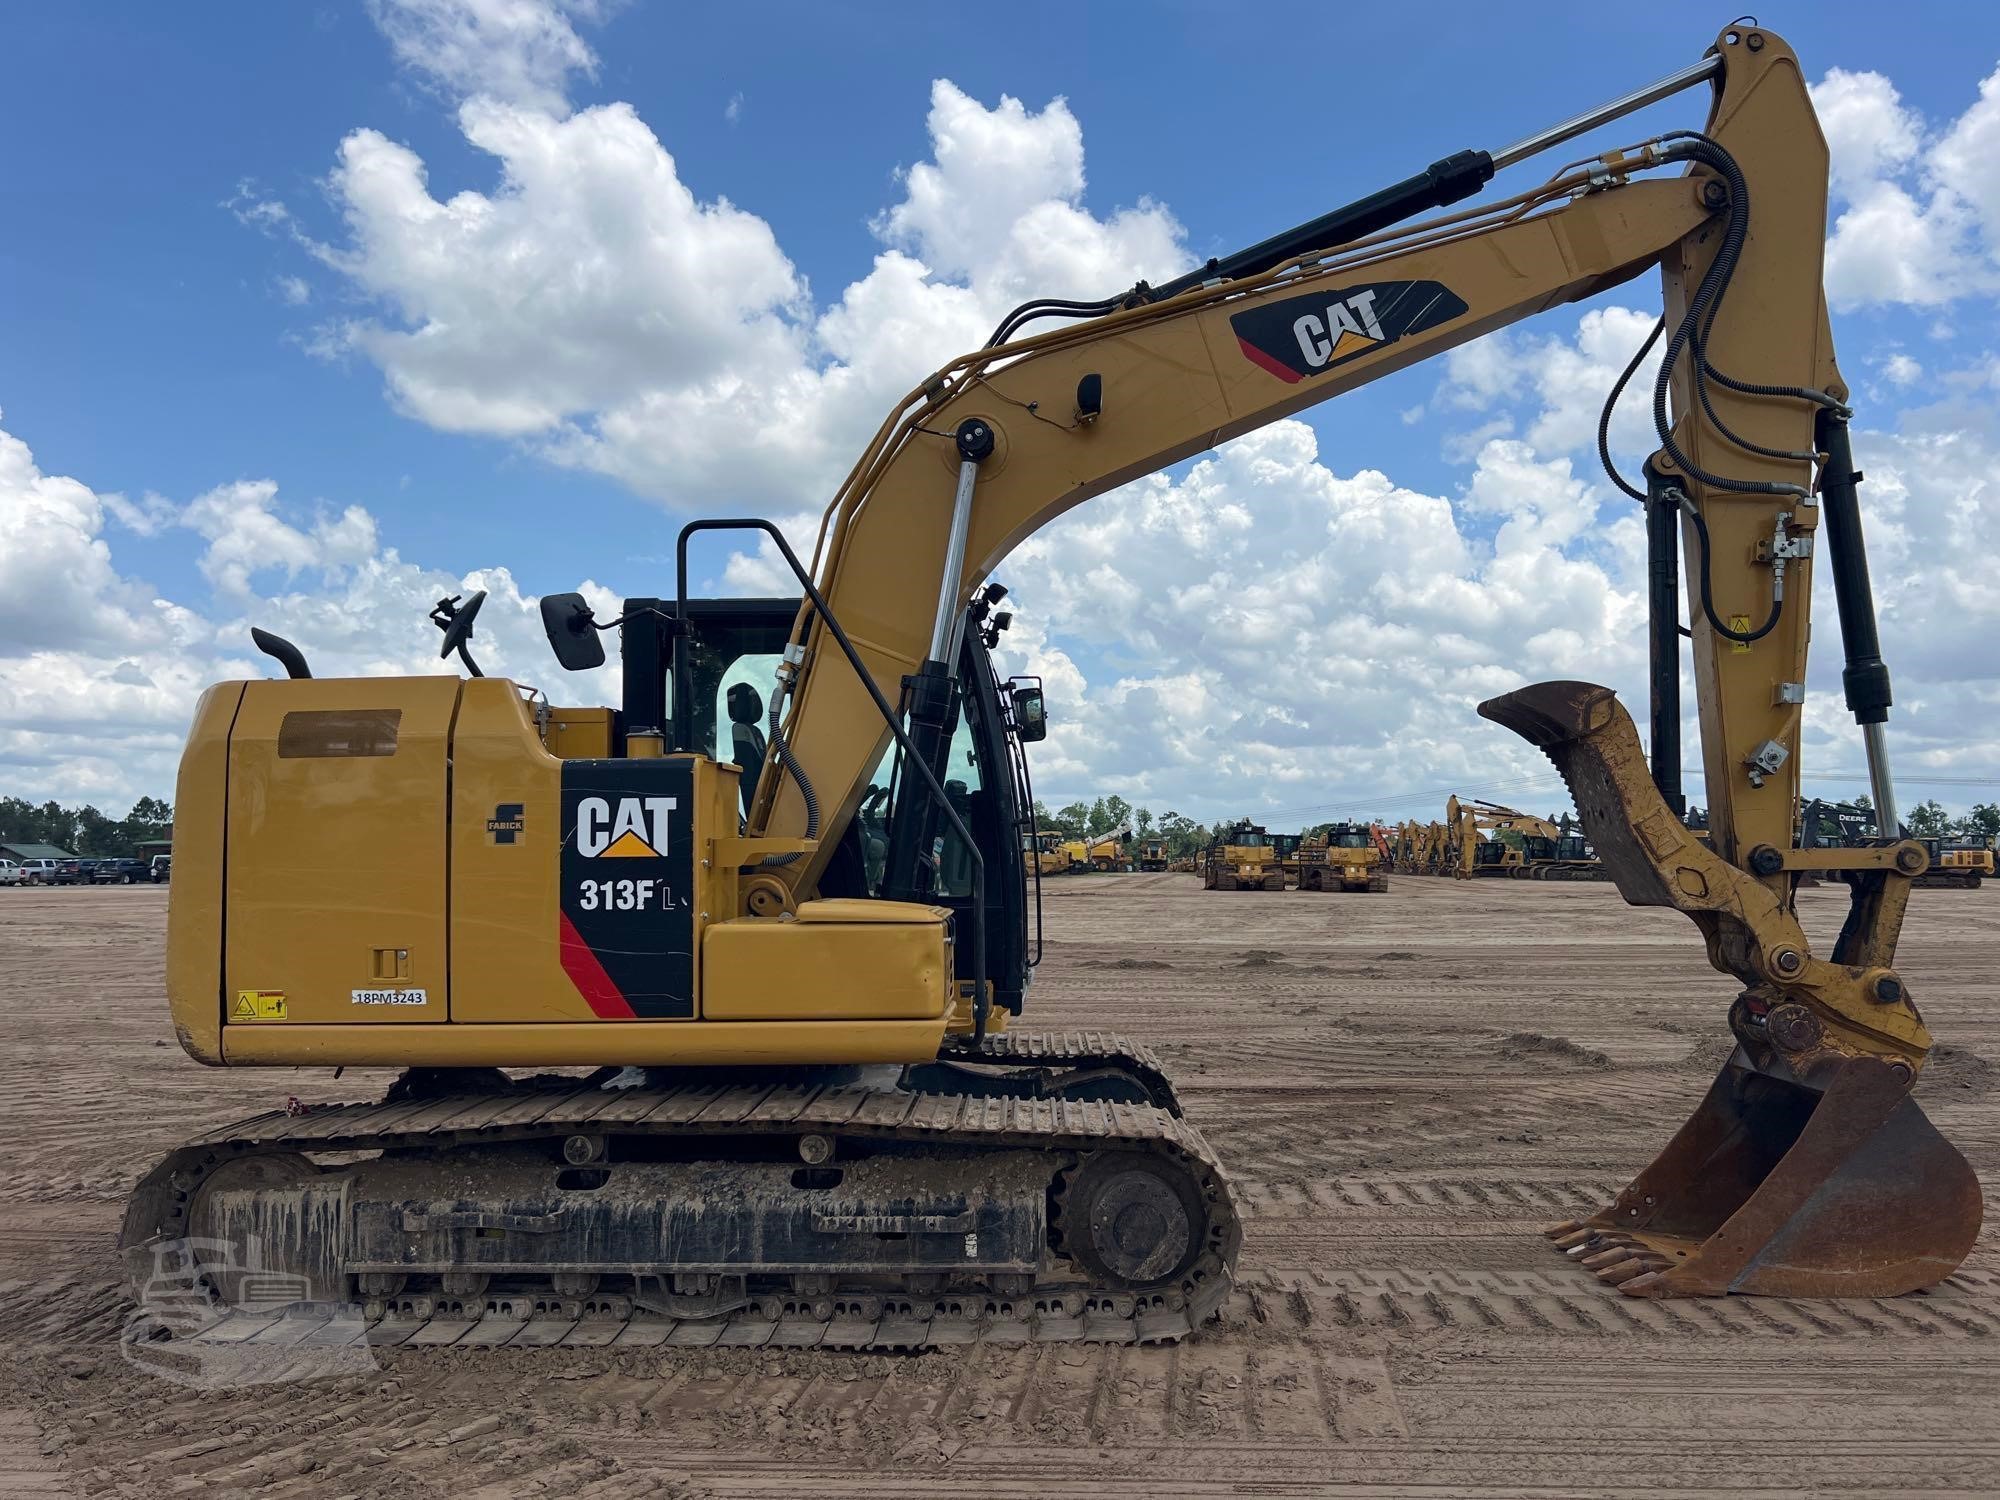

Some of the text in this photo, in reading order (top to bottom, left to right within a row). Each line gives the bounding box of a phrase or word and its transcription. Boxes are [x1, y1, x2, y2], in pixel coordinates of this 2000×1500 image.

[1293, 289, 1385, 367] CAT
[488, 822, 522, 830] FABICK
[577, 796, 677, 858] CAT
[1839, 814, 1867, 822] DEERE
[579, 879, 654, 911] 313F
[357, 992, 422, 1004] 18PM3243
